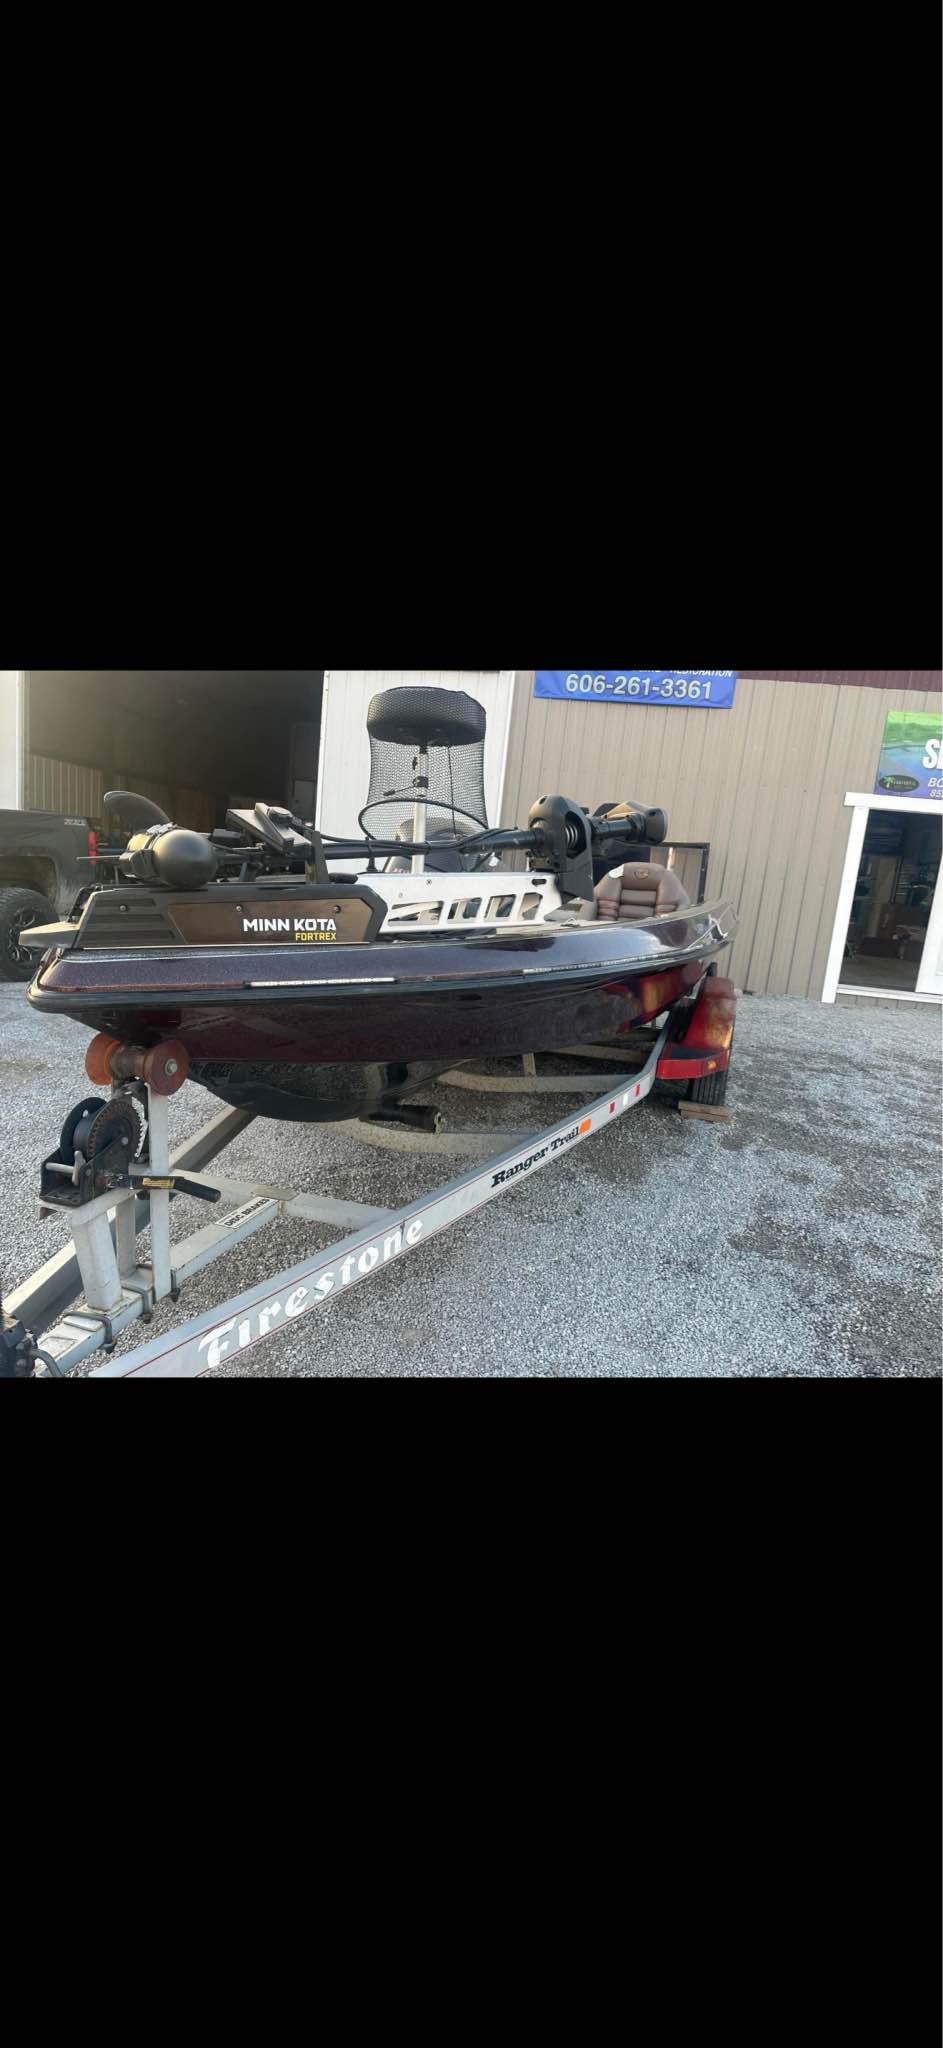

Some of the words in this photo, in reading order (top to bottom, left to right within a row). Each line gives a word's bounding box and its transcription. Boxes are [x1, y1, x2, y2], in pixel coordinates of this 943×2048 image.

[565, 673, 713, 700] 606-261-3361
[243, 918, 290, 932] MINN
[294, 918, 337, 931] KOTA
[295, 932, 337, 941] FORTREX
[491, 1147, 549, 1188] Ranger
[550, 1126, 580, 1152] Trail
[198, 1219, 424, 1369] Firestone
